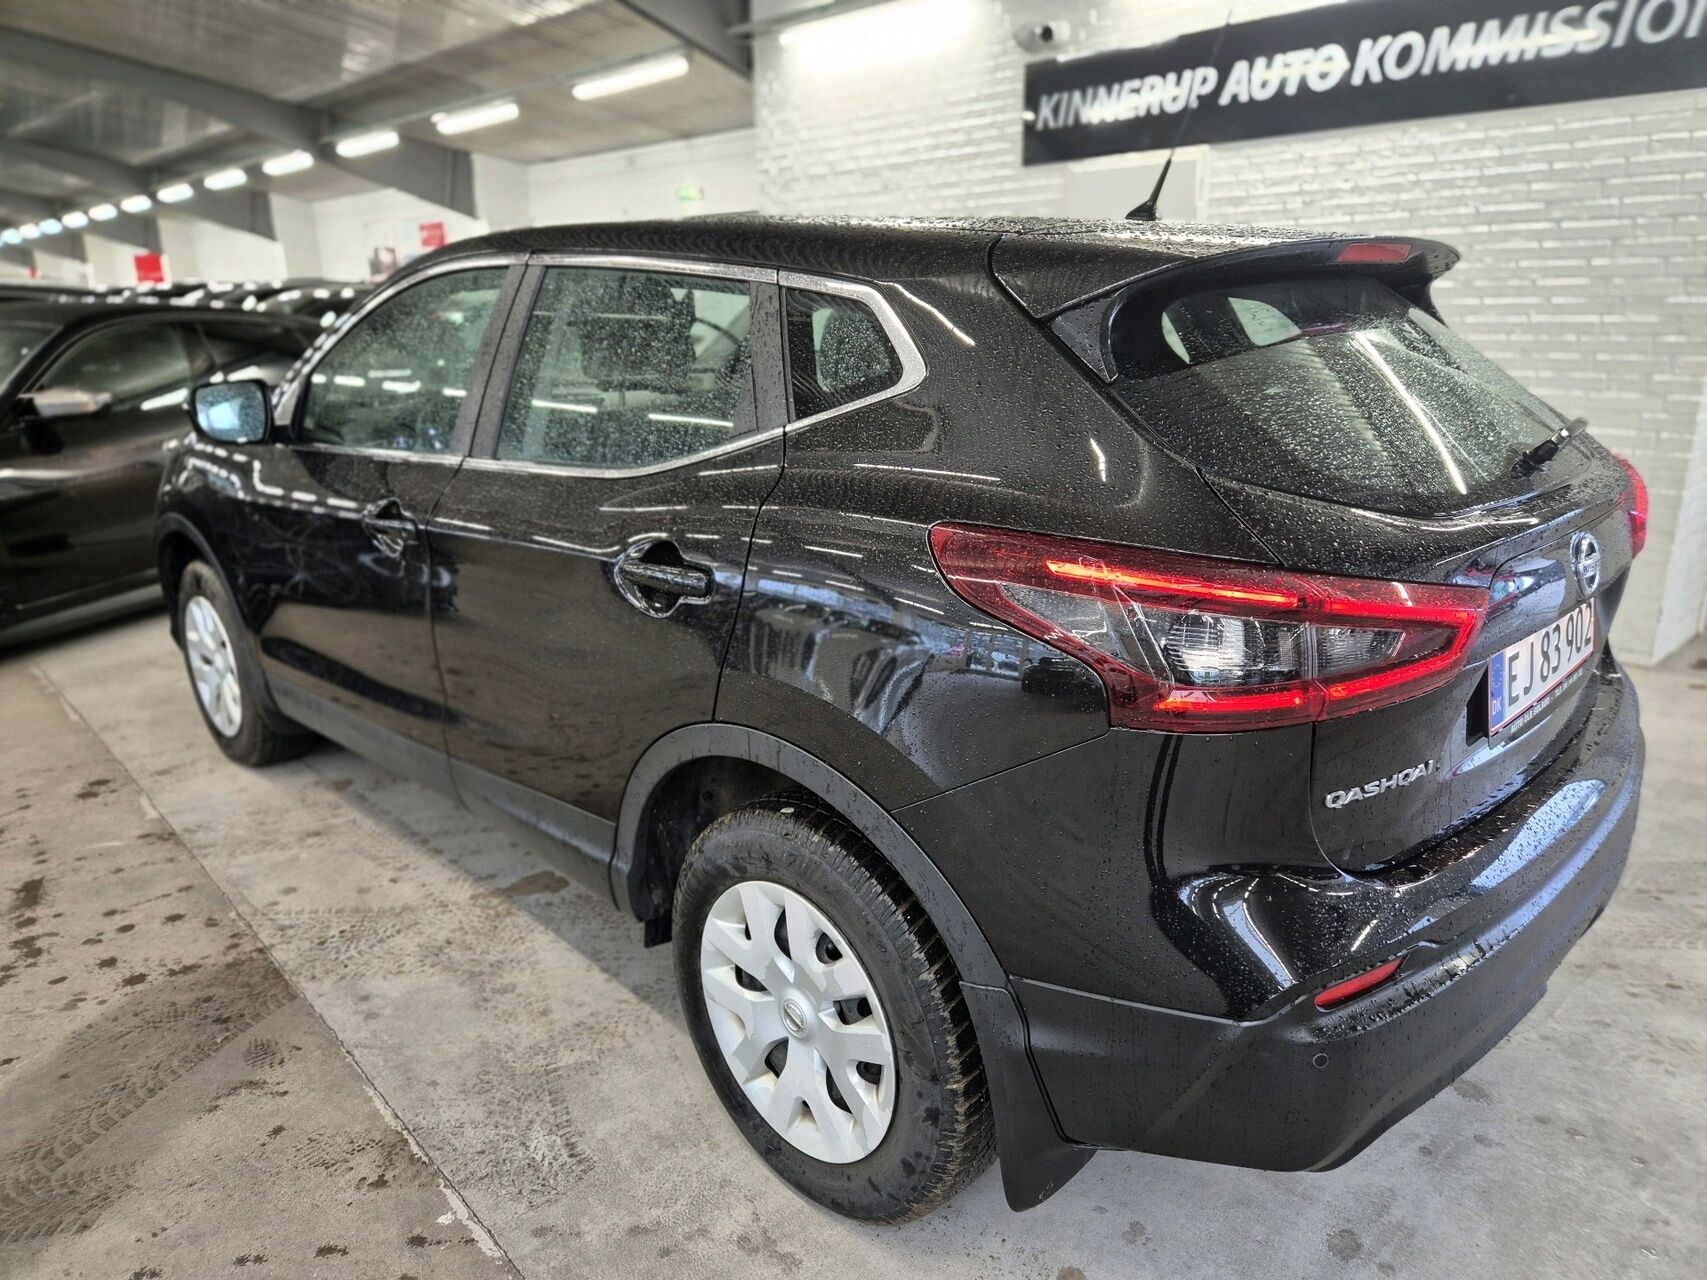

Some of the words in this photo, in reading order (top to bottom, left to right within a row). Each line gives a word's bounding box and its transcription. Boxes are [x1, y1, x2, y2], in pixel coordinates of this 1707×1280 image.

[1036, 66, 1219, 131] KINNERUP
[1218, 44, 1350, 105] AUTO
[1508, 641, 1535, 707] EJ
[1540, 623, 1561, 683] 83
[1566, 602, 1592, 662] 902
[1492, 696, 1502, 715] DK
[1325, 759, 1434, 809] QASHQAI
